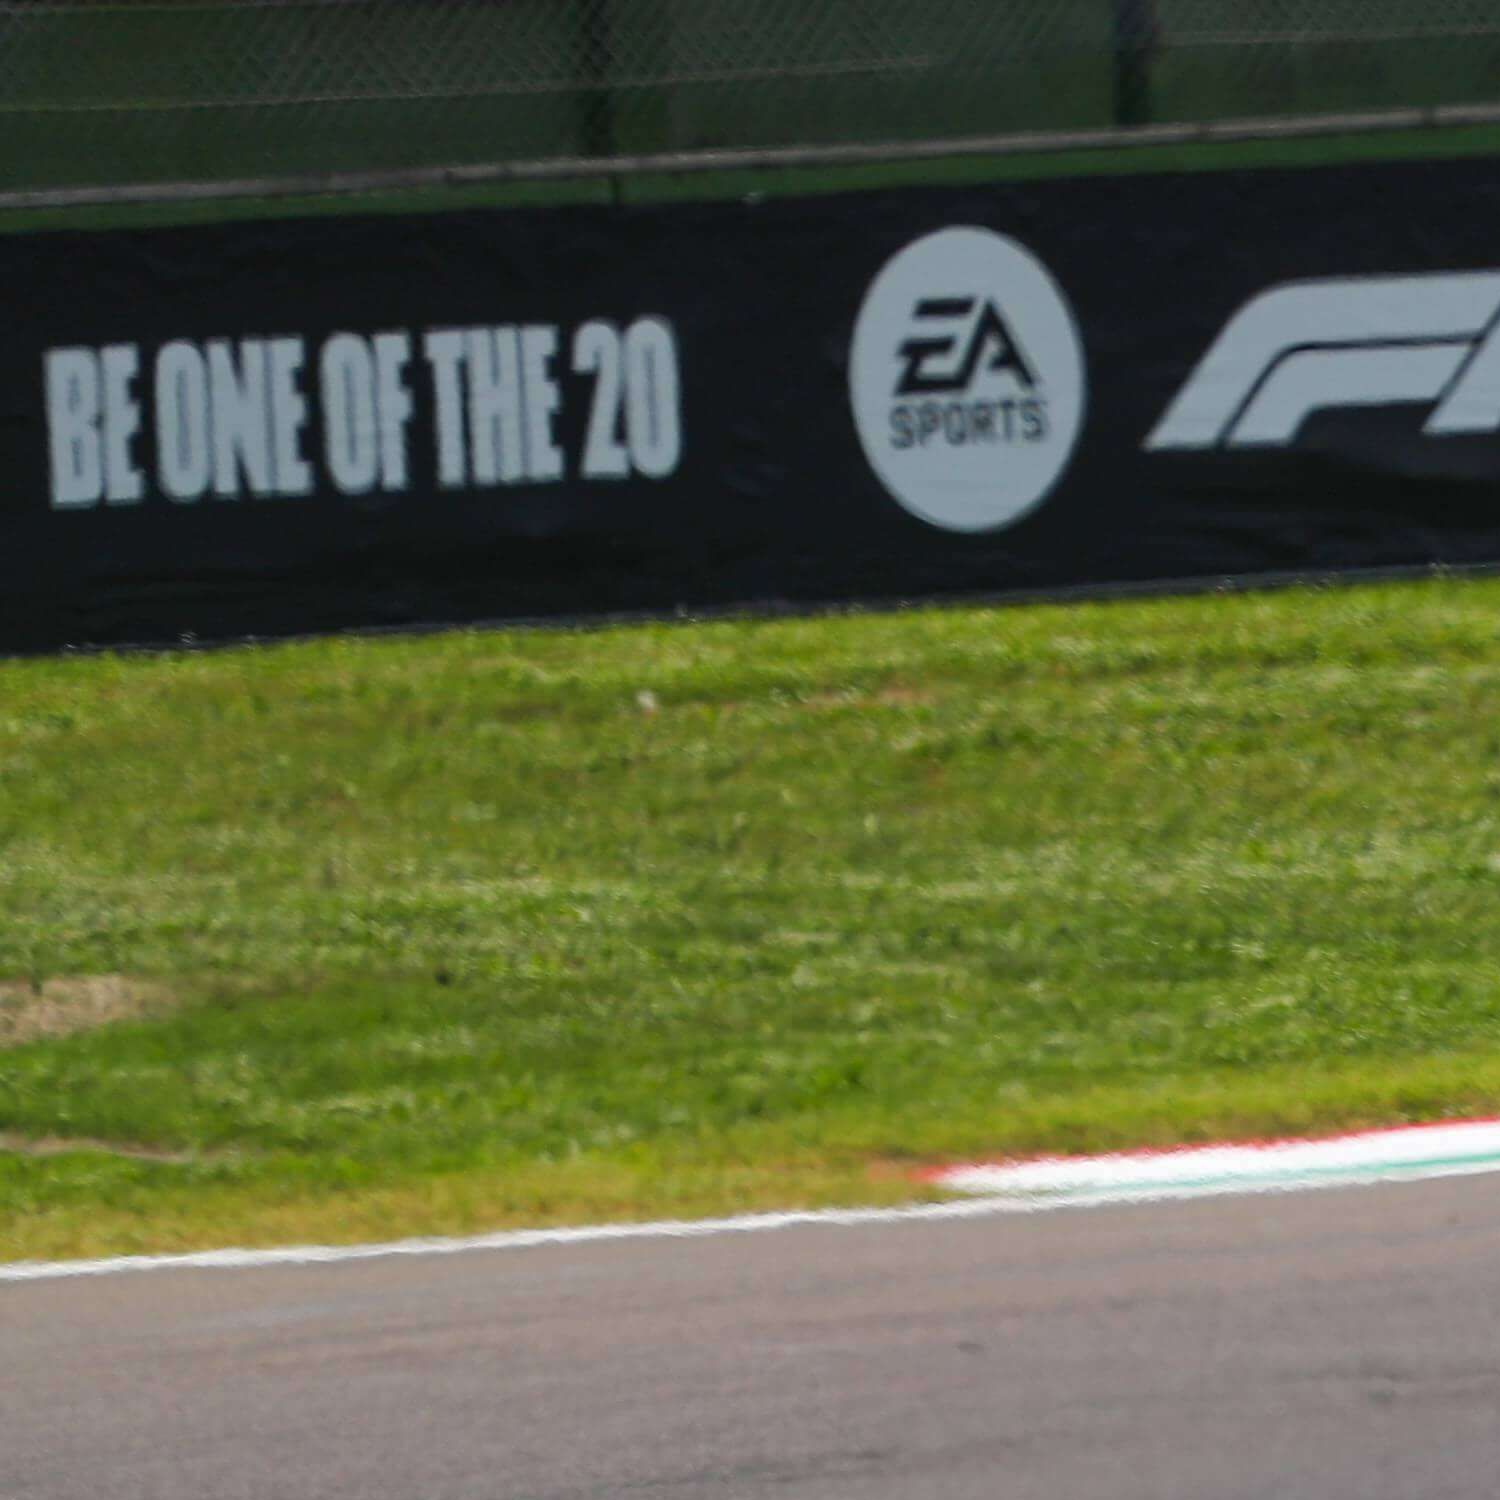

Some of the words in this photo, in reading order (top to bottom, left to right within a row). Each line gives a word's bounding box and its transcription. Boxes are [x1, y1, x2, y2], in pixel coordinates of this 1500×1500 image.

[892, 296, 1041, 396] EA
[44, 344, 142, 509] BE
[154, 336, 313, 504] ONE
[319, 330, 411, 496] OF
[424, 324, 564, 490] THE
[571, 314, 681, 481] 20
[888, 398, 1048, 452] SPORTS
